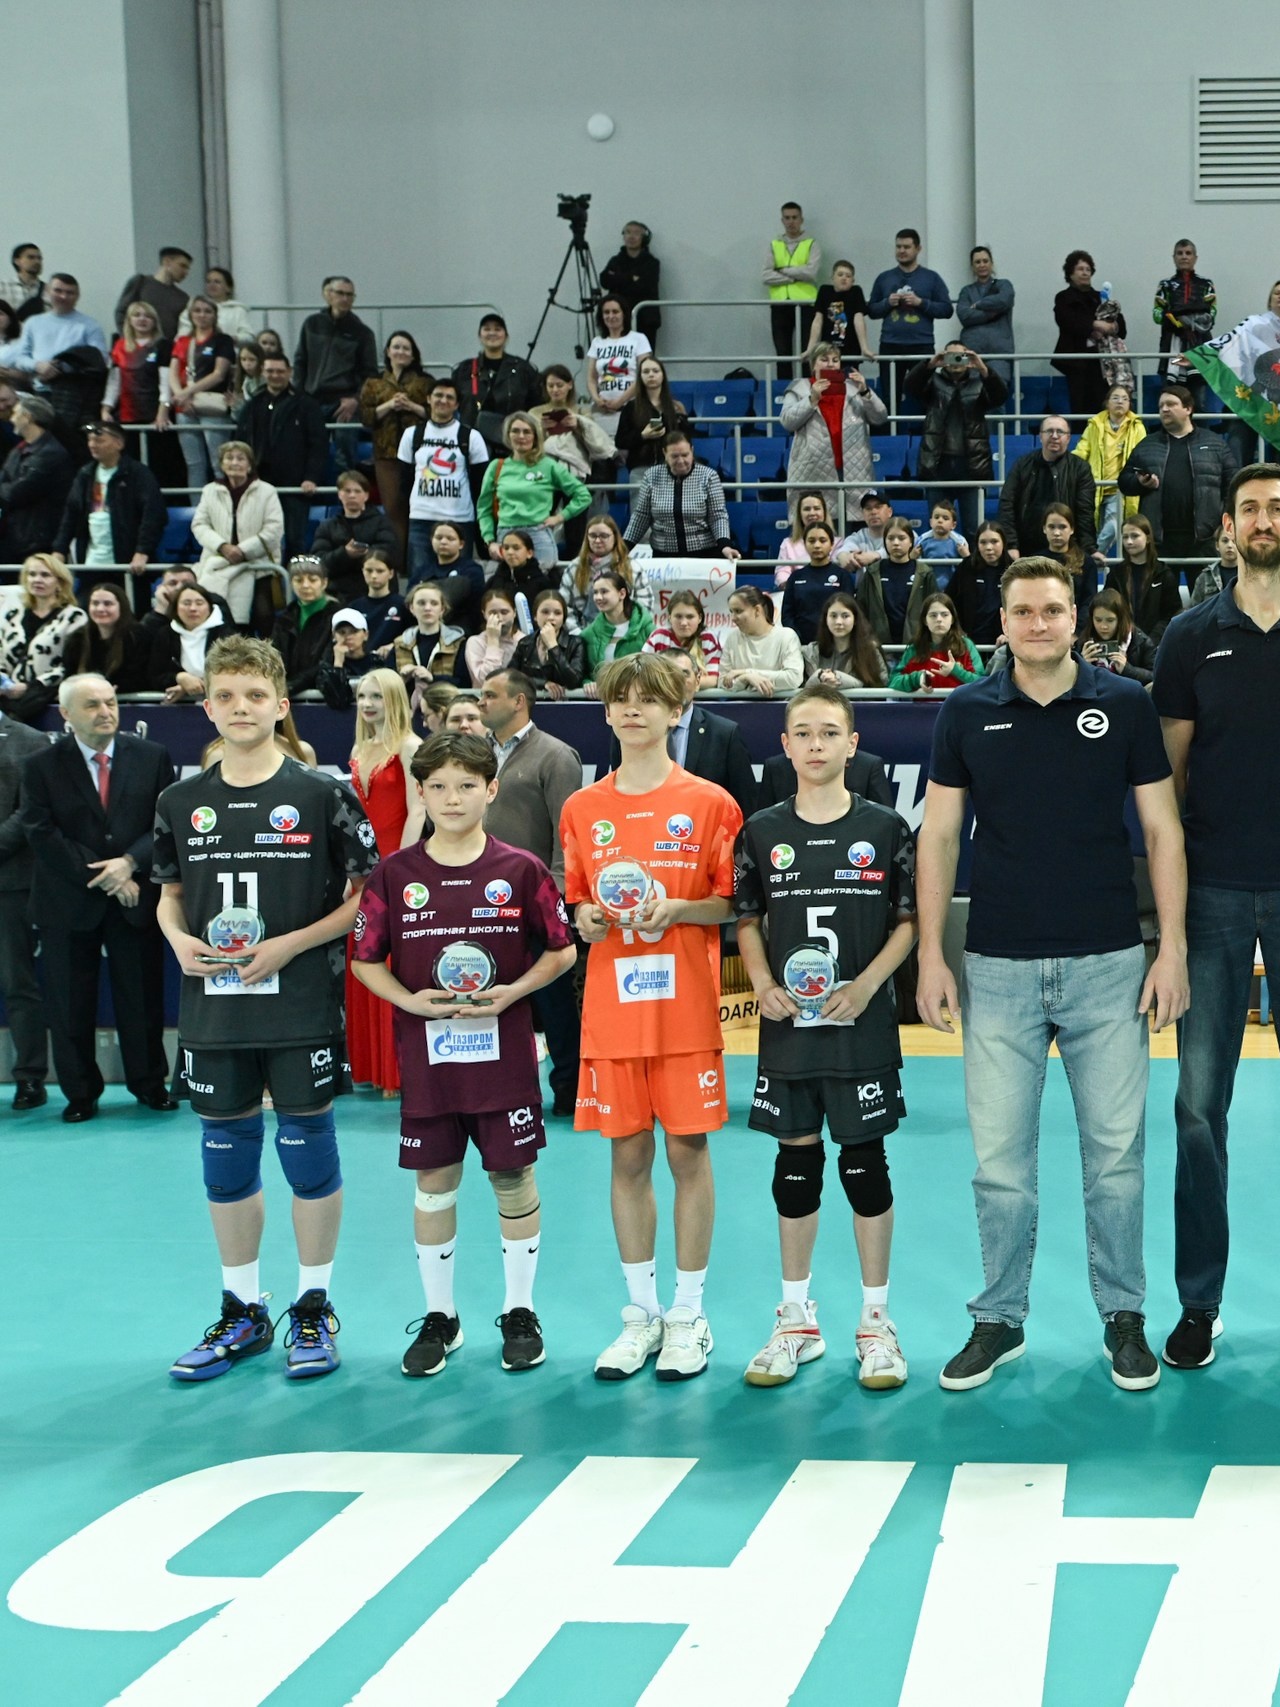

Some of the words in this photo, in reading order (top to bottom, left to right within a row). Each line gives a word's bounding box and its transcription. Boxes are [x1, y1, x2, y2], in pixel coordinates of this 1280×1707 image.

[625, 811, 655, 819] ENSEN
[206, 835, 222, 845] РТ
[257, 834, 283, 843] ШВЛ
[285, 834, 310, 843] ПРО
[655, 842, 679, 850] ШВЛ
[785, 872, 801, 882] РТ
[836, 870, 860, 879] ШВЛ
[862, 871, 883, 880] ПРО
[420, 910, 437, 921] РТ
[474, 908, 498, 917] ШВЛ
[500, 908, 520, 917] ПРО
[806, 906, 839, 961] 5
[452, 1032, 494, 1044] ГАЗПРОМ
